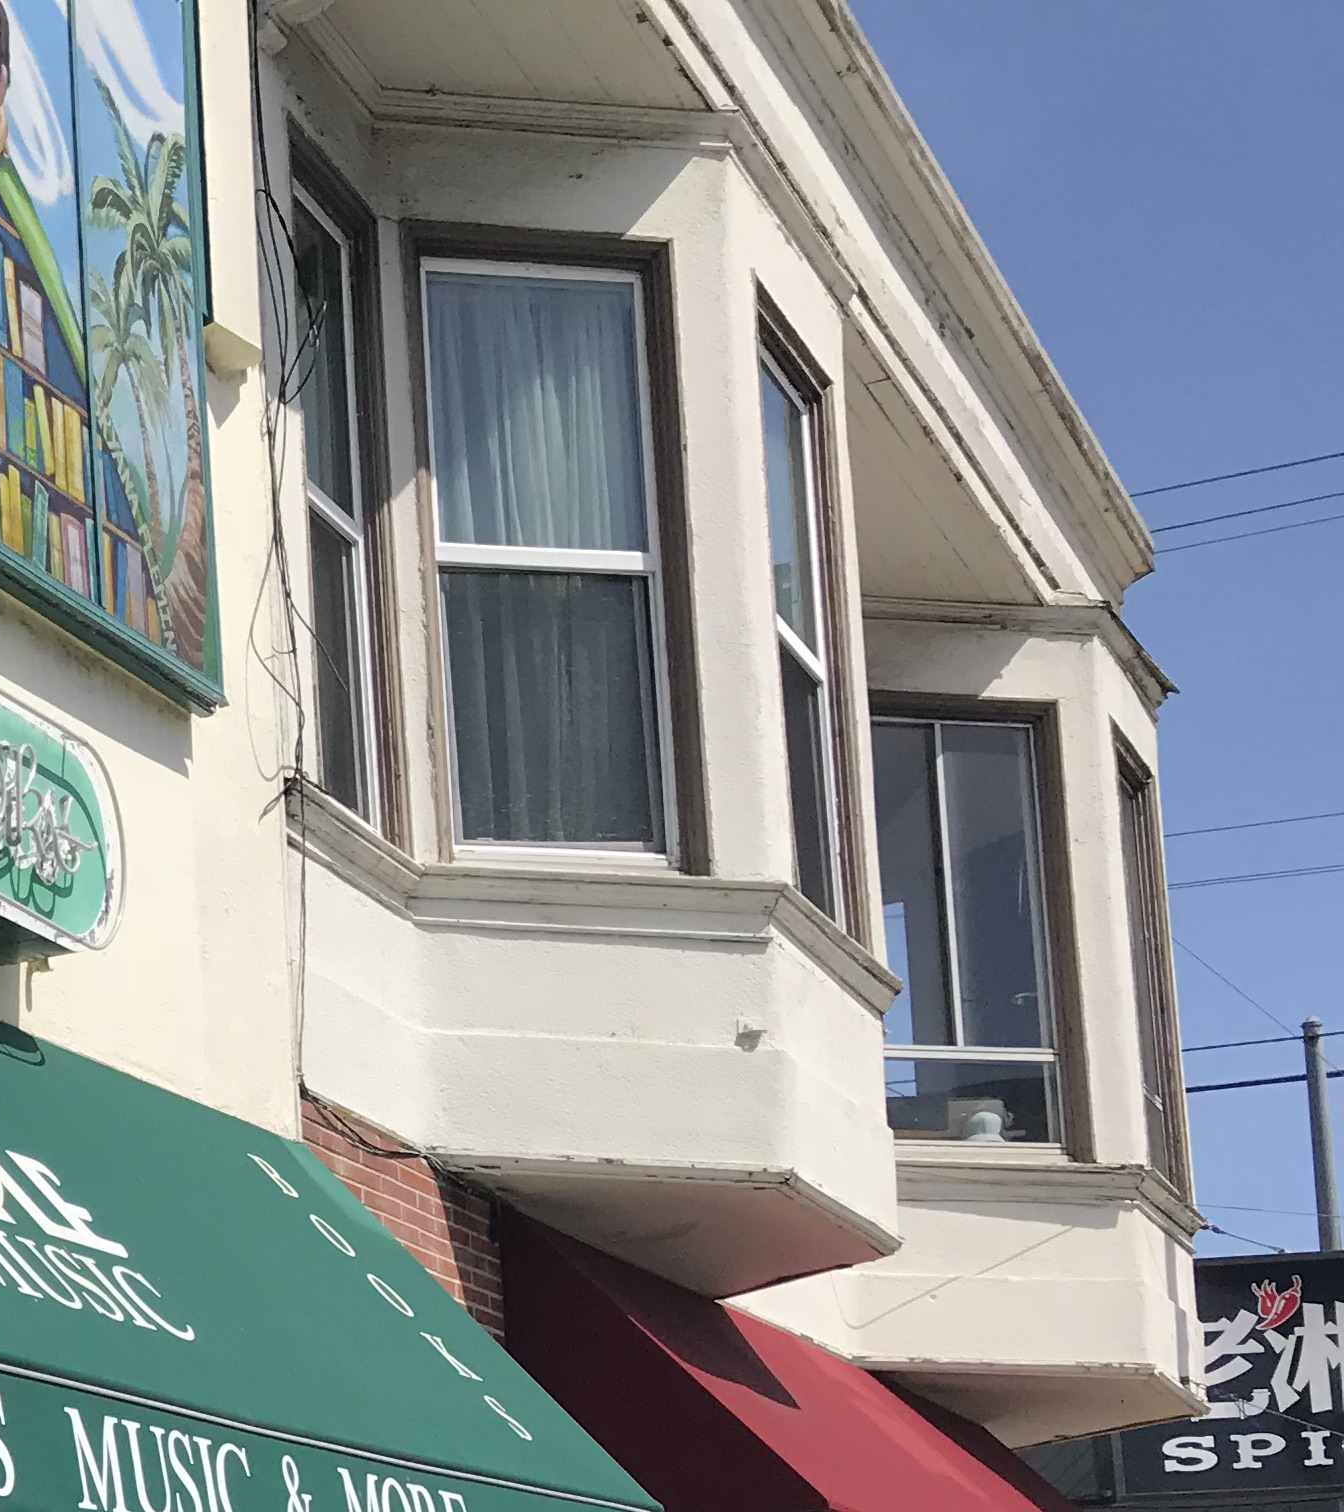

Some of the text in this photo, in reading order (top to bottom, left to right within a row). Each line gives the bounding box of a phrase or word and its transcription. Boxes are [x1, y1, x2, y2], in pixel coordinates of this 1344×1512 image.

[137, 523, 178, 656] FLEMIN
[248, 1152, 534, 1441] BOOKS
[1162, 1431, 1344, 1473] SPI
